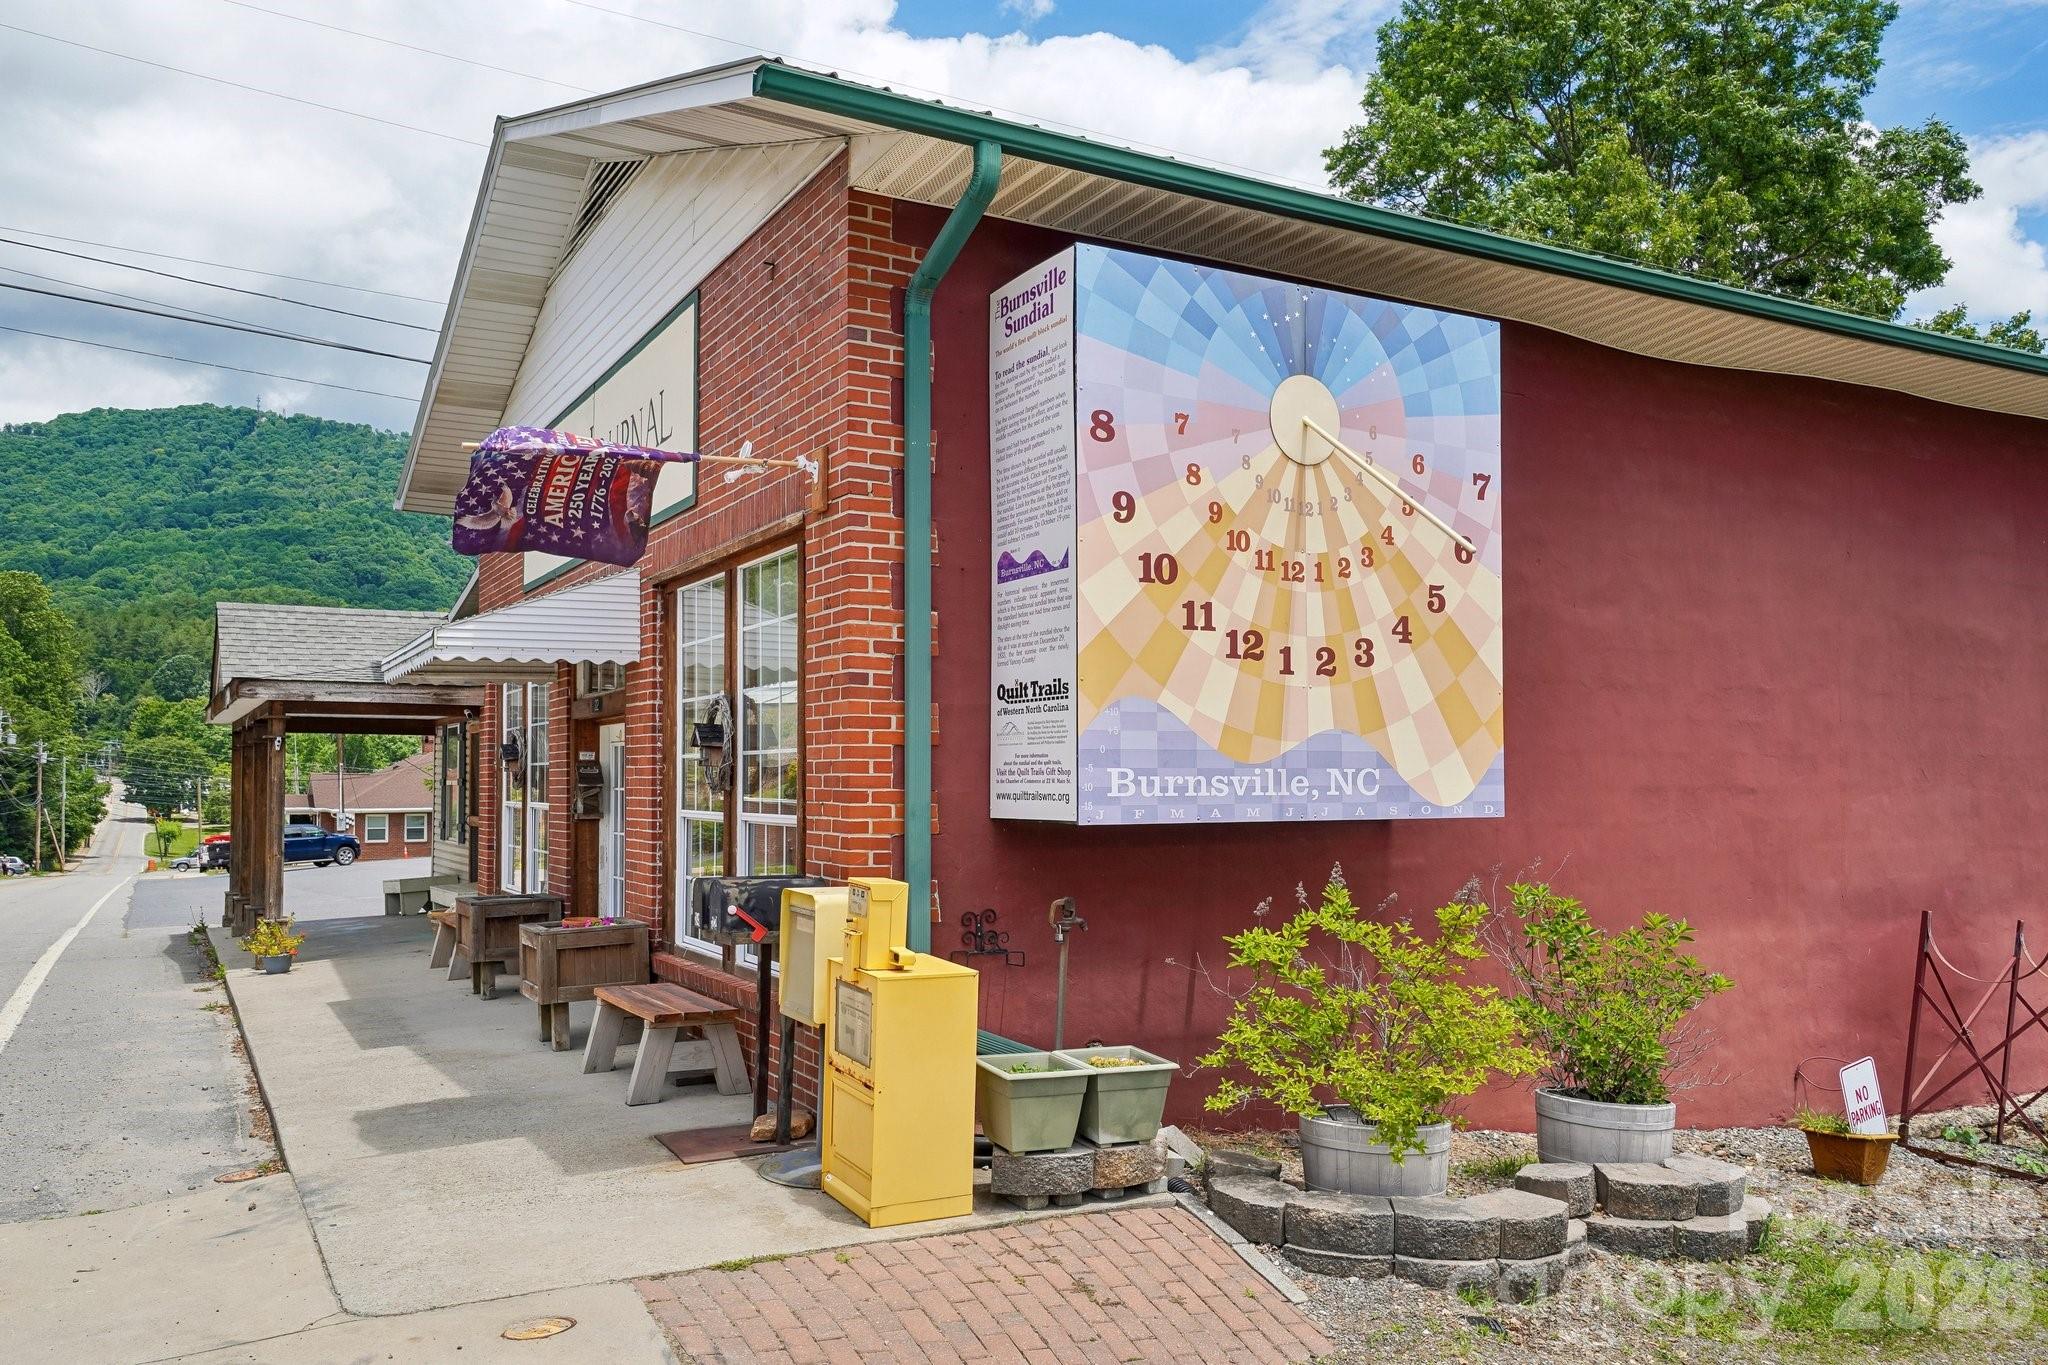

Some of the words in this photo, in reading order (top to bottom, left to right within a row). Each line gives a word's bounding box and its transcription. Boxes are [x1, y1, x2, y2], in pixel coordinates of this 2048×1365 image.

[1000, 266, 1066, 319] Burnsville
[1005, 292, 1053, 338] Sundial
[1090, 410, 1115, 442] 8
[1175, 413, 1189, 435] 7
[1369, 426, 1377, 440] 6
[1232, 428, 1240, 444] 7
[575, 451, 602, 490] YEAR
[1242, 455, 1250, 470] 8
[1412, 454, 1425, 475] 6
[1186, 463, 1201, 485] 8
[1255, 475, 1264, 489] 9
[1357, 472, 1363, 486] 4
[543, 454, 580, 529] AMERIC
[591, 488, 607, 519] 1776
[600, 456, 617, 478] 202
[1268, 488, 1281, 504] 10
[1344, 487, 1352, 501] 3
[1473, 473, 1491, 500] 7
[568, 492, 585, 519] 250
[1112, 491, 1135, 523] 9
[1209, 502, 1222, 523] 9
[1284, 497, 1295, 512] 11
[1298, 501, 1313, 517] 12
[1317, 502, 1323, 516] 1
[1330, 497, 1338, 512] 2
[1402, 496, 1415, 516] 5
[1227, 530, 1250, 552] 10
[1381, 526, 1394, 545] 4
[1255, 550, 1275, 571] 11
[1361, 547, 1374, 567] 3
[1454, 536, 1473, 564] 6
[1138, 553, 1178, 585] 10
[1281, 561, 1305, 582] 12
[1314, 562, 1324, 582] 1
[1338, 558, 1351, 578] 2
[1427, 585, 1446, 613] 5
[1182, 601, 1216, 631] 11
[1392, 616, 1412, 644] 4
[1226, 630, 1264, 661] 12
[1355, 638, 1374, 667] 3
[1279, 646, 1294, 675] 1
[1316, 647, 1336, 677] 2
[997, 681, 1028, 704] Quilt
[1030, 677, 1068, 696] Trails
[997, 708, 1002, 716] of
[1002, 706, 1024, 715] Western
[1025, 705, 1041, 713] North
[1042, 702, 1068, 712] Carolina
[1016, 768, 1029, 776] Quilt
[1057, 767, 1071, 776] Shop
[1107, 767, 1319, 800] Burnsville,
[1326, 767, 1379, 796] NC
[996, 790, 1070, 804] www.quilttrailswnc.org
[1096, 810, 1104, 820] J
[1134, 810, 1144, 819] F
[1170, 809, 1185, 819] M
[1211, 809, 1222, 818] A
[1247, 808, 1260, 817] M
[1286, 807, 1294, 817] J
[1322, 807, 1329, 816] J
[1355, 806, 1365, 816] A
[1390, 806, 1397, 815] S
[1422, 806, 1431, 815] O
[1453, 806, 1463, 814] N
[1484, 806, 1494, 814] D
[1855, 1085, 1868, 1104] NO
[1850, 1100, 1881, 1127] PARKING
